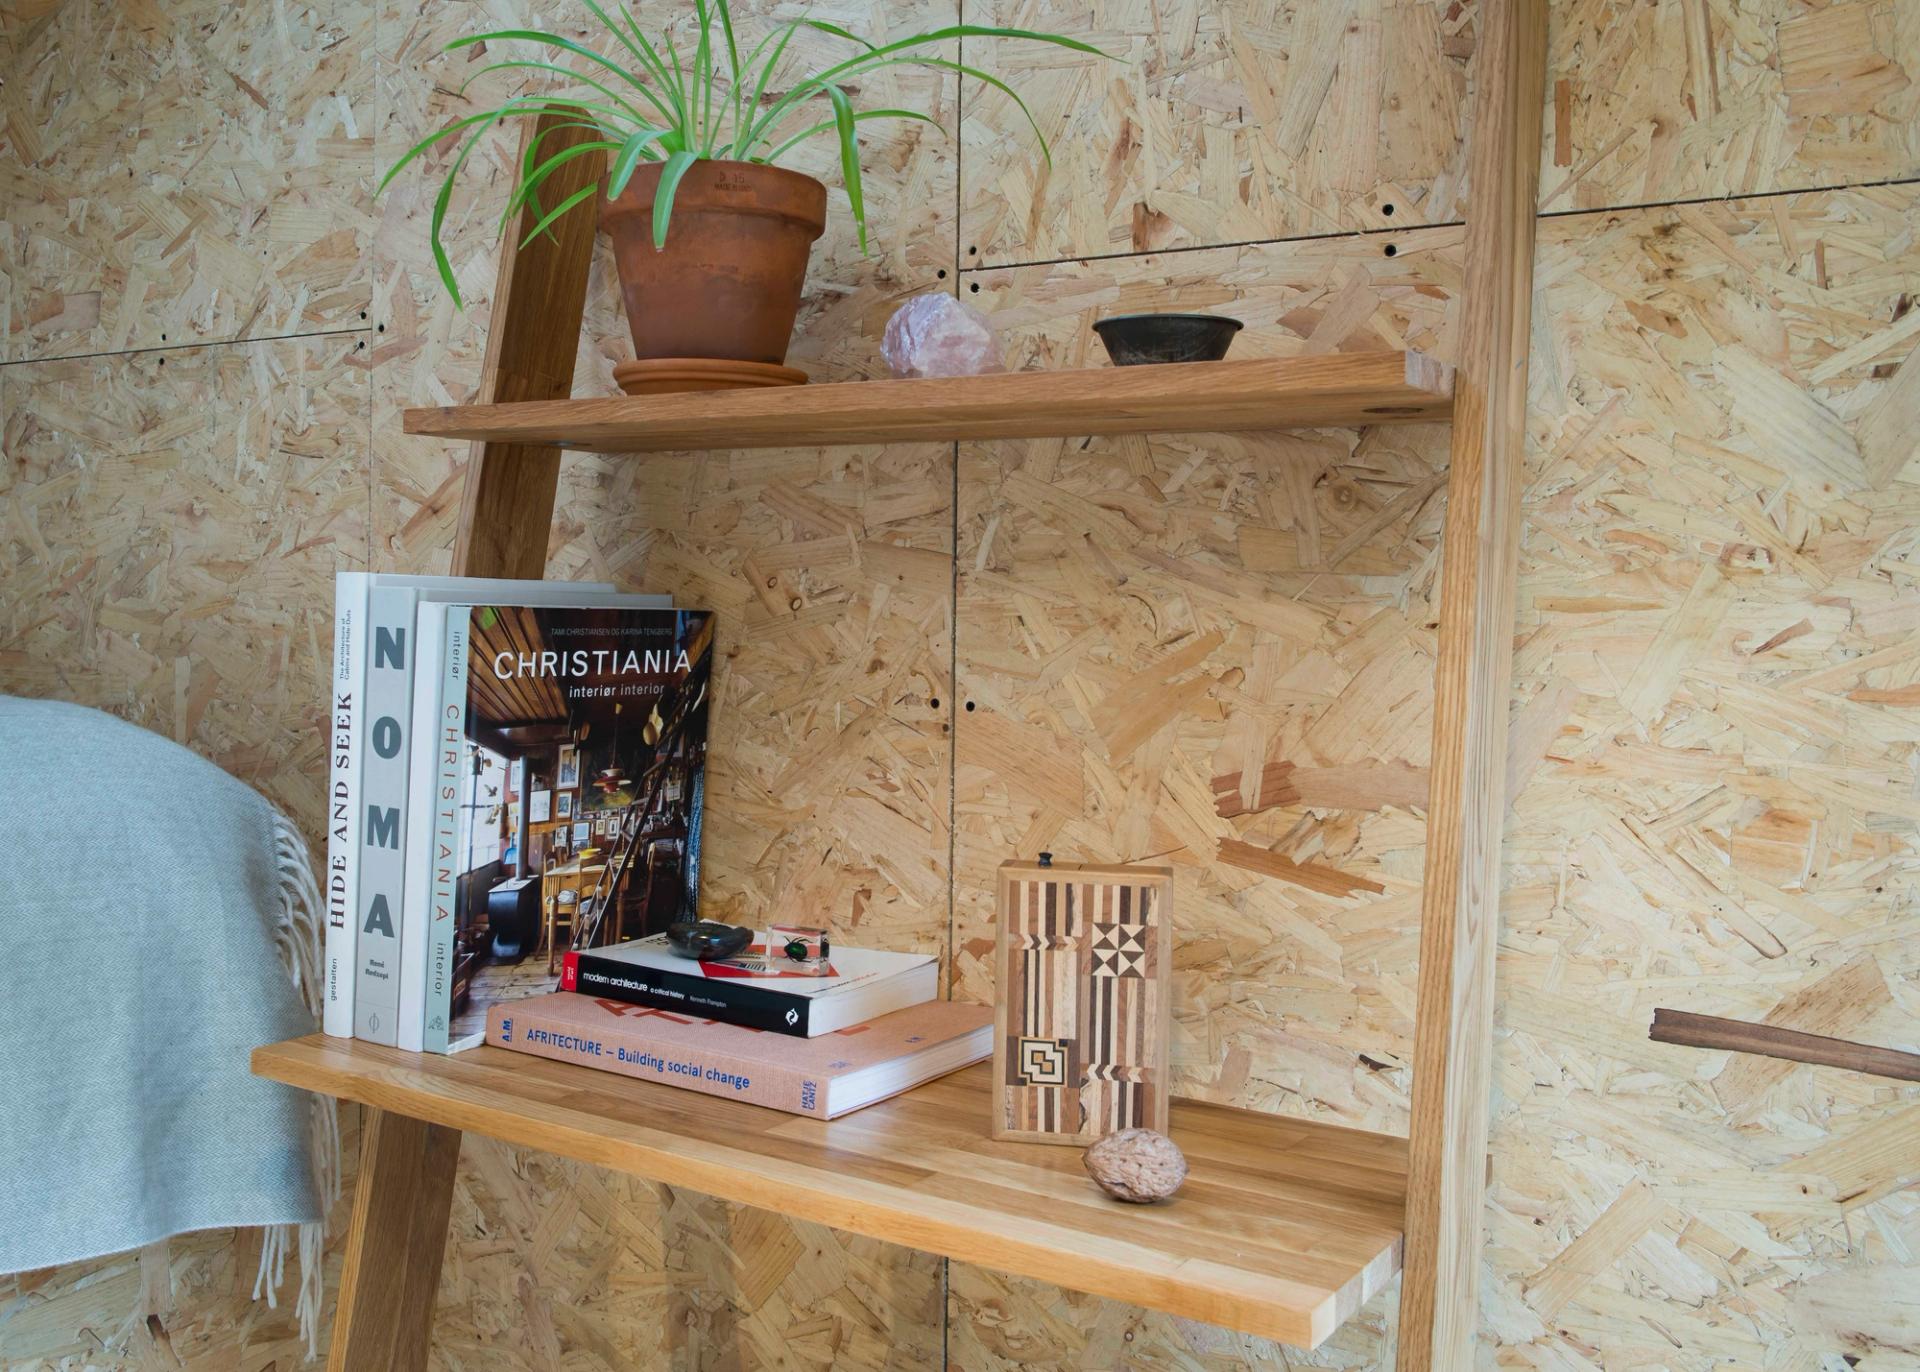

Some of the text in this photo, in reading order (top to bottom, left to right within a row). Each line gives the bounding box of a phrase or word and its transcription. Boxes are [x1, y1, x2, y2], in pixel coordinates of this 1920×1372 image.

[566, 628, 610, 636] CHRISTIANSEN
[451, 631, 462, 680] interiør
[493, 649, 693, 680] CHRISTIANIA
[569, 682, 665, 698] interiør interior
[330, 692, 352, 930] HIDE AND SEEK
[436, 704, 460, 921] CHRISTIANIA
[330, 958, 338, 1001] gestalten
[365, 968, 389, 981] Redzepi
[369, 959, 385, 968] René
[434, 942, 447, 997] interior
[583, 972, 610, 984] modern
[609, 979, 648, 992] architecture
[654, 988, 670, 997] critical
[669, 990, 685, 1000] history
[690, 995, 707, 1004] Kenneth
[707, 998, 727, 1008] Frampton
[527, 1029, 602, 1056] AFRITECTURE
[618, 1048, 665, 1072] Building
[668, 1059, 702, 1078] social
[706, 1067, 750, 1090] change
[802, 1080, 810, 1109] HATJE
[807, 1080, 817, 1110] CANTZ
